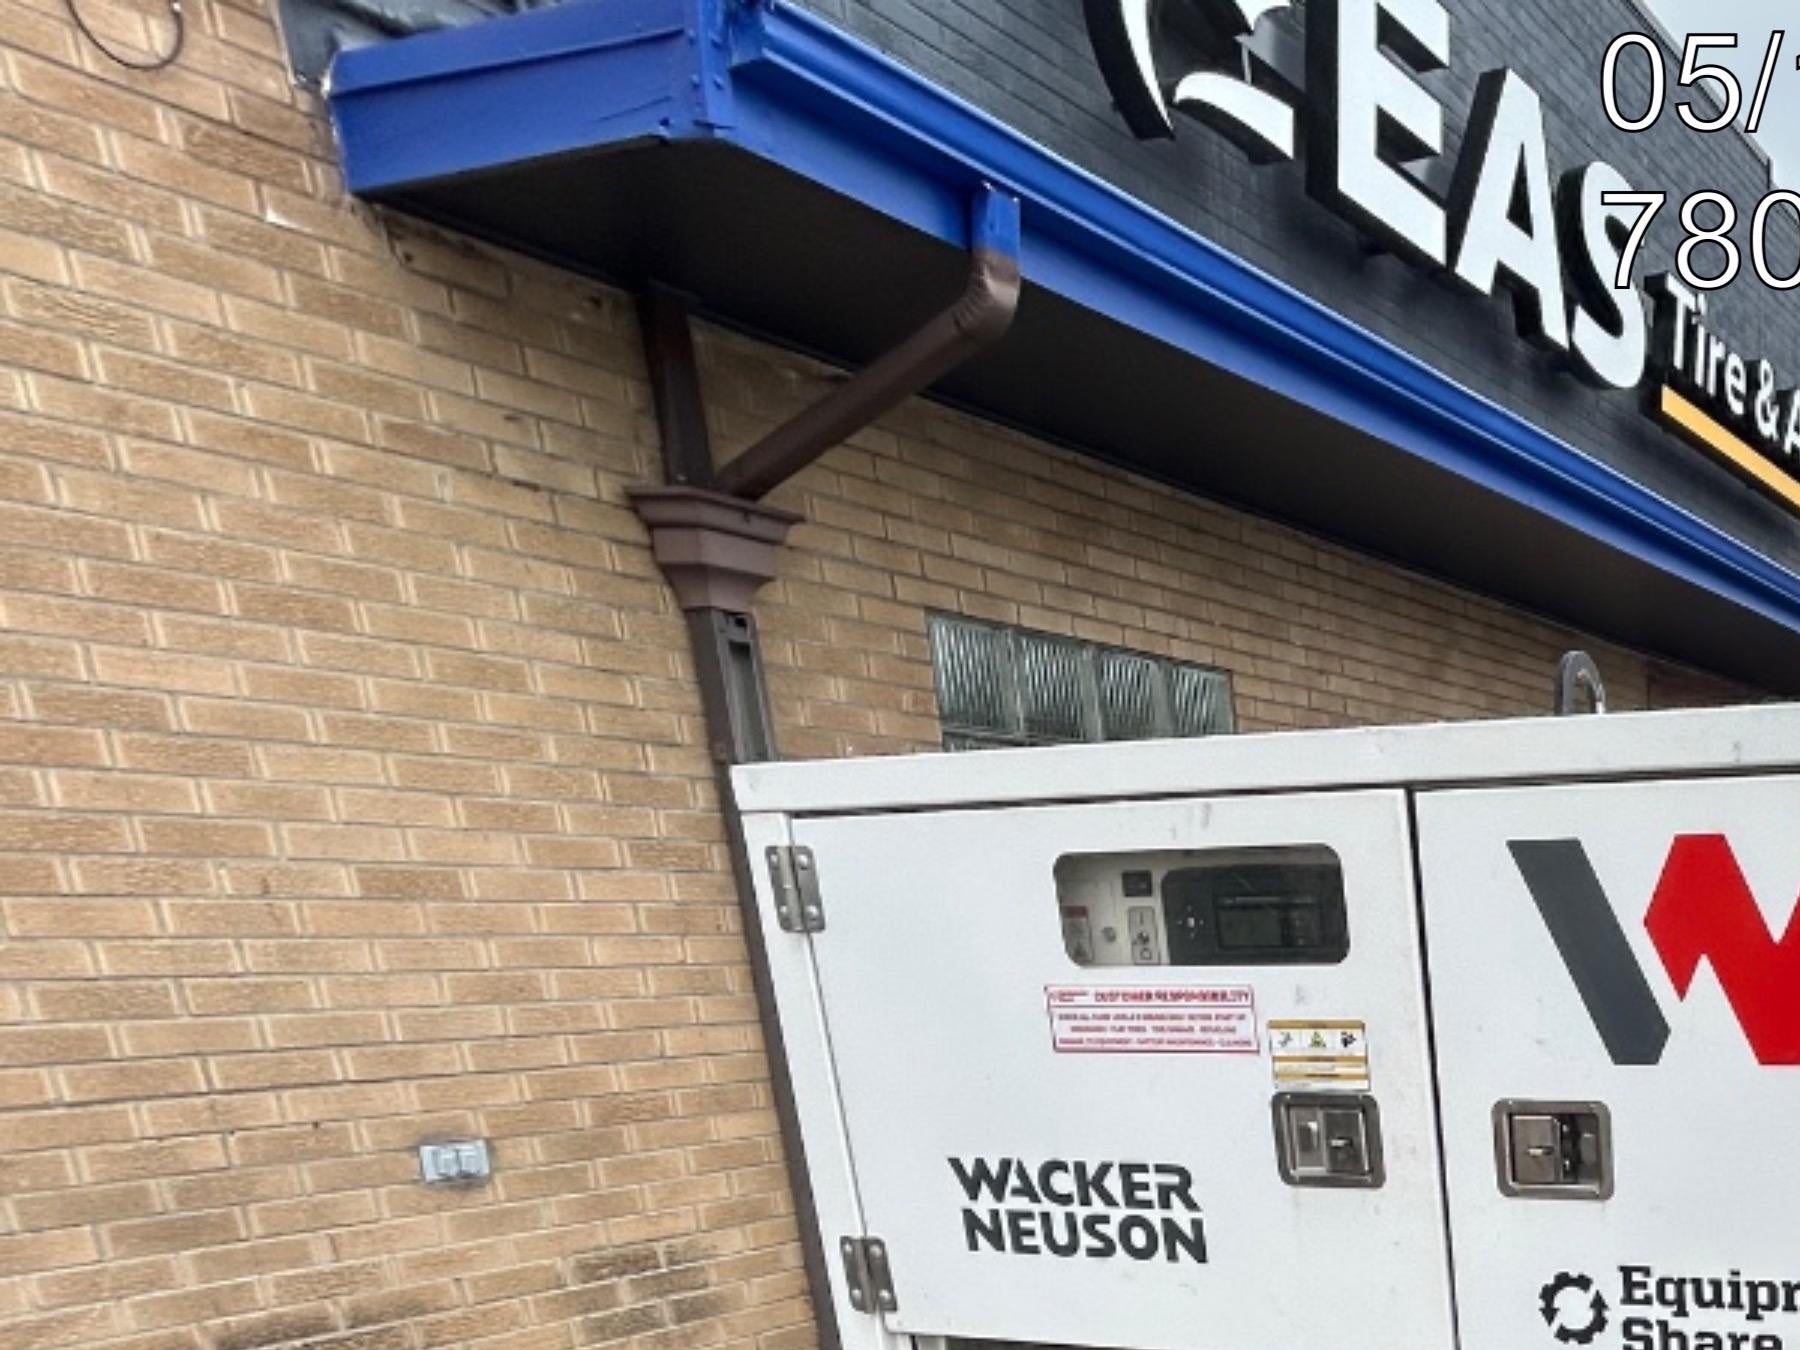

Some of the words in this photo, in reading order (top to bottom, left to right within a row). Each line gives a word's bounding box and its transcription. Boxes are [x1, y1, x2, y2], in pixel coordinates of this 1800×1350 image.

[1666, 272, 1747, 416] Tire
[1754, 358, 1781, 442] &
[947, 1156, 1202, 1213] WACKER
[961, 1207, 1209, 1264] NEUSON
